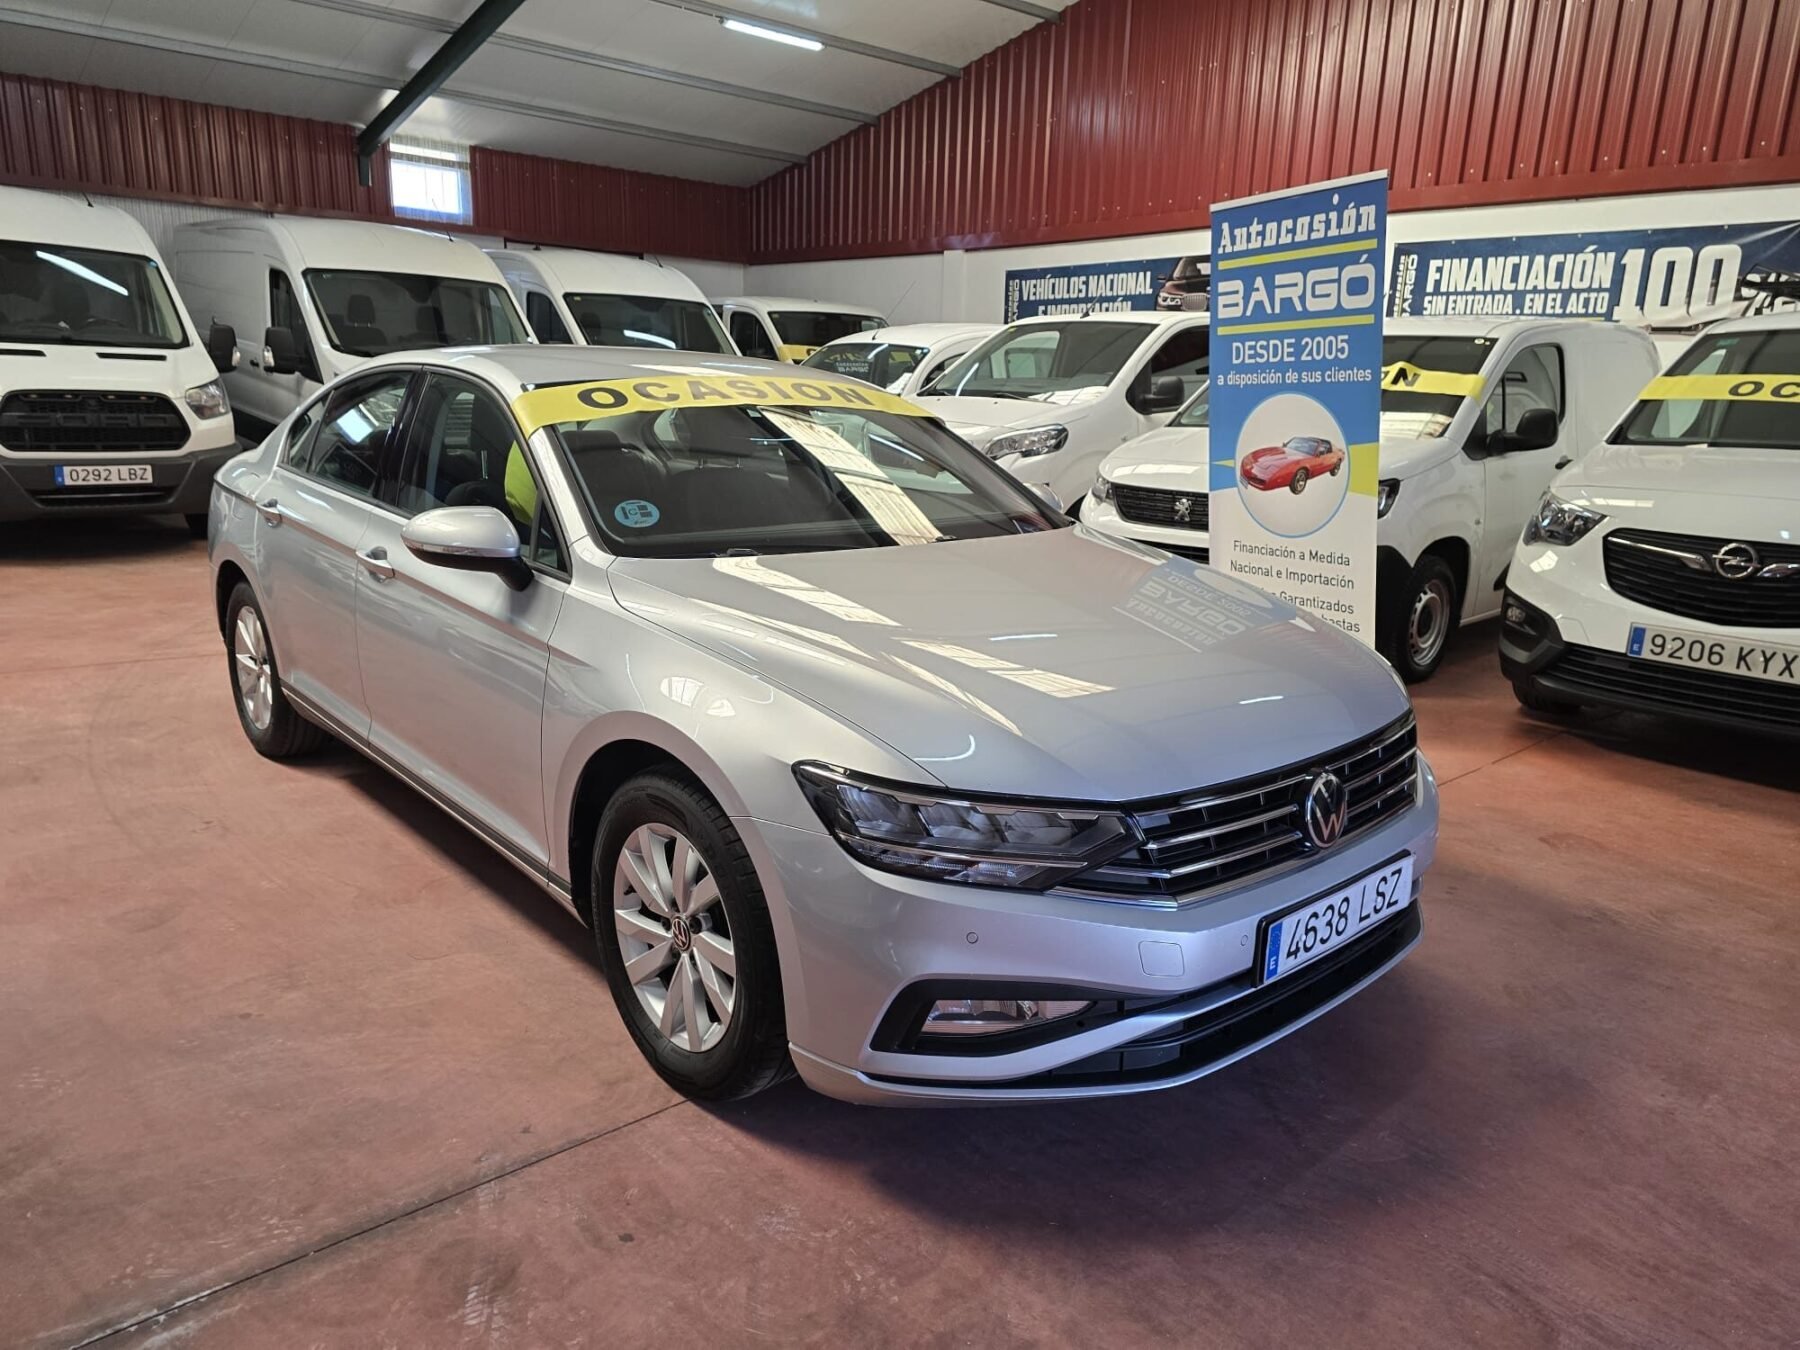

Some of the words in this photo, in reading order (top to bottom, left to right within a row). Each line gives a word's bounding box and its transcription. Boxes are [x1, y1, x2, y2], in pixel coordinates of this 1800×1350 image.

[1218, 193, 1376, 254] Autocasión
[1426, 245, 1616, 293] FINANCIACIÓN
[1022, 274, 1086, 301] VEHÍCULOS
[1088, 271, 1153, 298] NACIONAL
[1218, 254, 1375, 319] BARGÓ
[1423, 295, 1446, 315] SIN
[1447, 294, 1513, 315] ENTRADA
[1524, 293, 1544, 314] EN
[1545, 293, 1563, 314] EL
[1565, 292, 1610, 314] ACTO
[1232, 338, 1295, 364] DESDE
[1301, 335, 1349, 361] 2005
[1217, 374, 1224, 385] a
[1227, 369, 1282, 388] disposición
[1285, 368, 1298, 383] de
[1301, 371, 1322, 383] sus
[1325, 366, 1372, 382] clientes
[577, 380, 876, 408] OCASION
[69, 468, 113, 482] 0292
[117, 468, 149, 481] LBZ
[1234, 540, 1295, 559] Financiación
[1299, 551, 1305, 560] a
[1309, 549, 1350, 566] Medida
[1230, 560, 1273, 577] Nacional
[1276, 569, 1282, 579] e
[1286, 567, 1354, 589] Importación
[1650, 634, 1726, 666] 9206
[1736, 646, 1799, 678] KYX
[1269, 957, 1276, 969] E
[1286, 896, 1349, 960] 4638
[1359, 867, 1403, 924] LSZ
